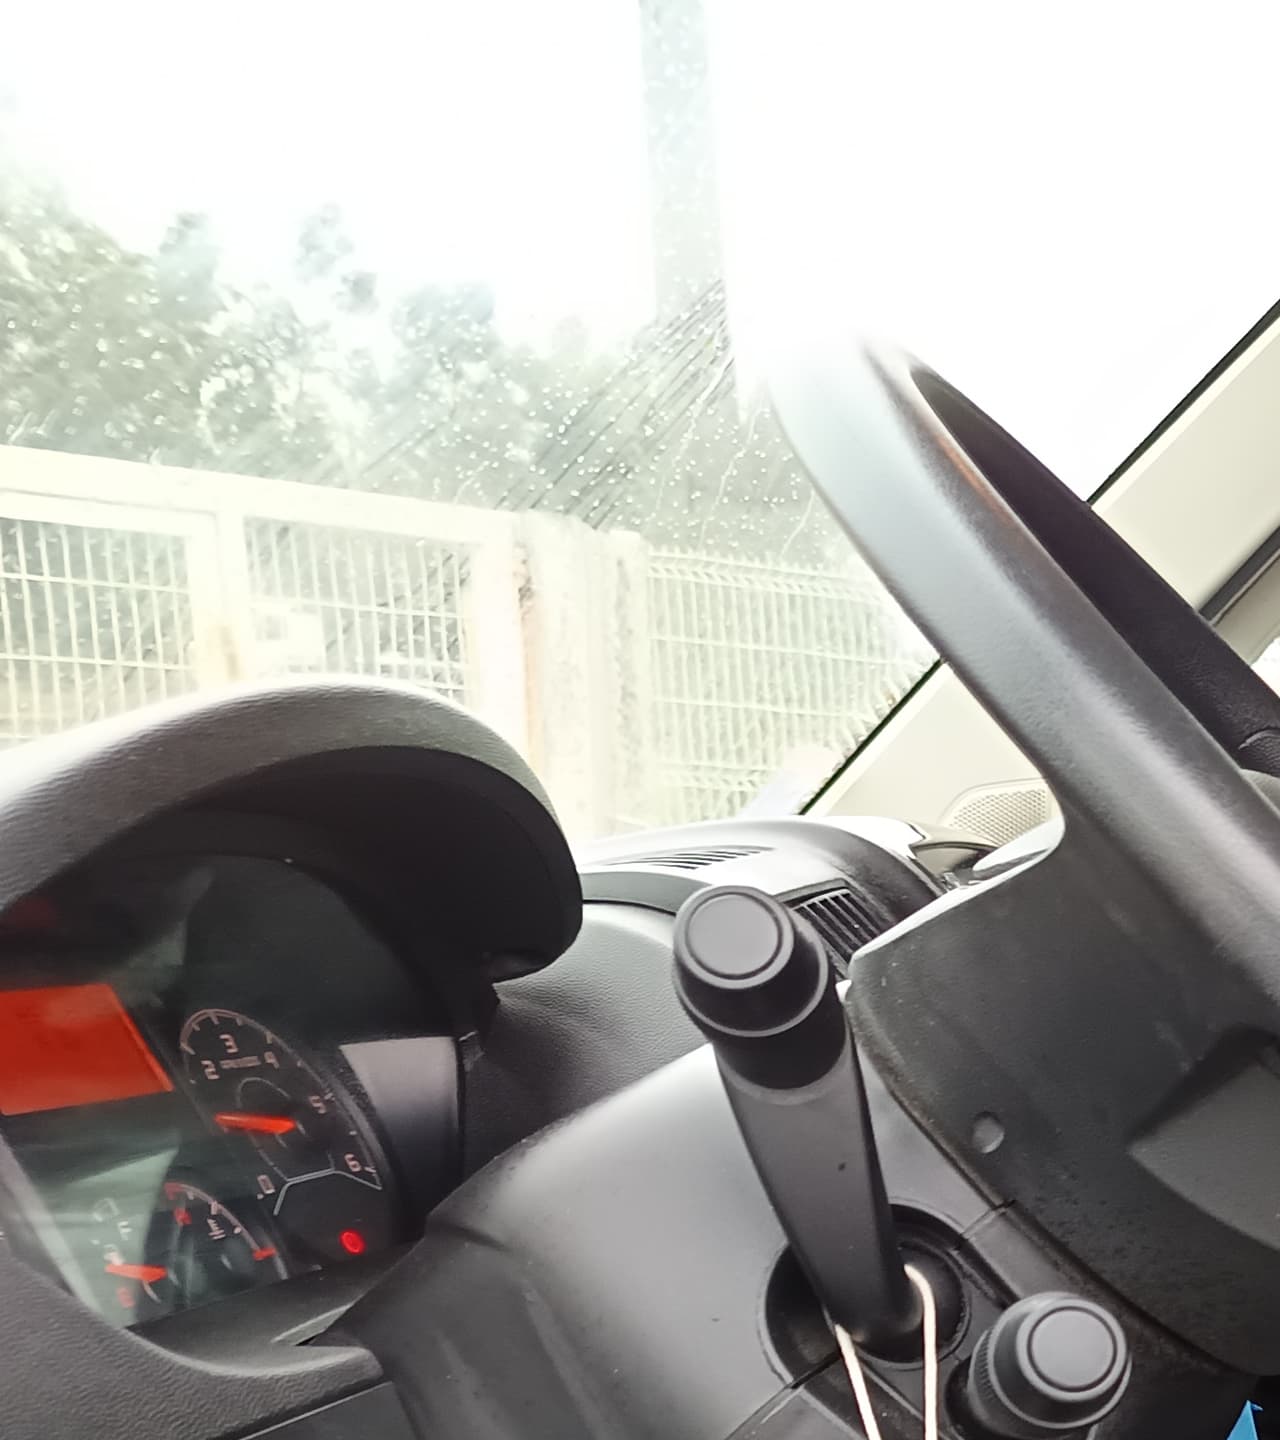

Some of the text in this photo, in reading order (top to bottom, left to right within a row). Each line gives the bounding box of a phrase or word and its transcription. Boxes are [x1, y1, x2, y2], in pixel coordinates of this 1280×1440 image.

[219, 1034, 239, 1053] 3
[201, 1060, 220, 1080] 2
[309, 1095, 326, 1114] 5
[344, 1153, 361, 1172] 6
